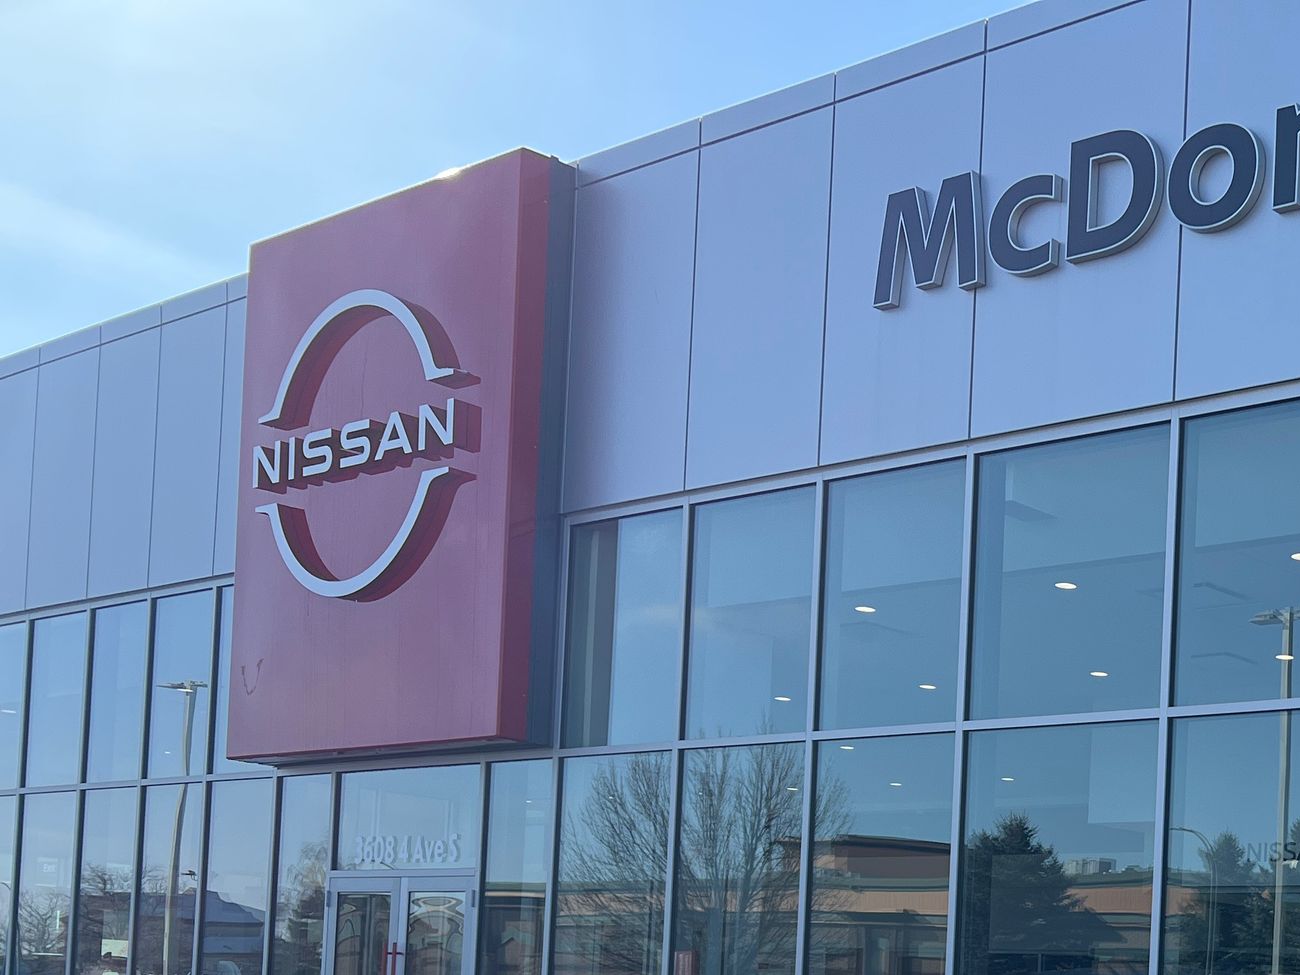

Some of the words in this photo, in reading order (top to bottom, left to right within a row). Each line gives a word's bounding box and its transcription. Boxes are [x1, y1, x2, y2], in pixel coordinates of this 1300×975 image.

[253, 397, 454, 489] NISSAN
[354, 834, 396, 865] 3608
[399, 835, 411, 864] 4
[414, 834, 447, 864] Ave
